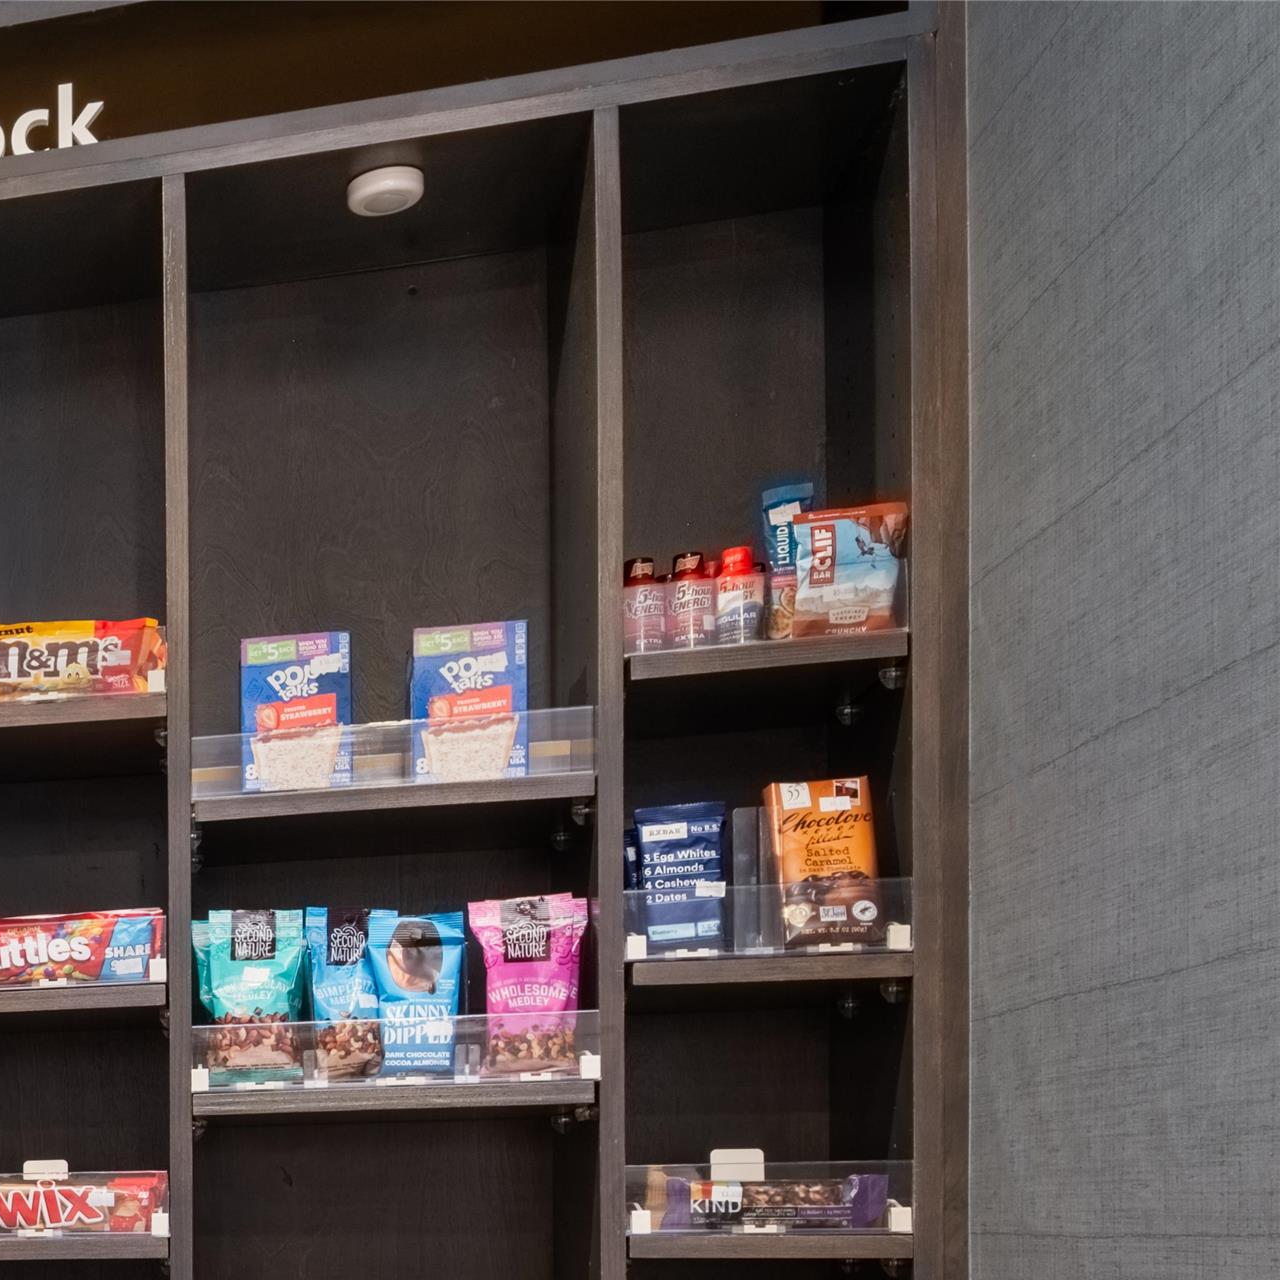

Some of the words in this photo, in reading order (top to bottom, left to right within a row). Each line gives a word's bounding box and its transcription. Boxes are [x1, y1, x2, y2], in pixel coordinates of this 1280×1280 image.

[814, 528, 833, 572] CLIF
[813, 571, 832, 579] BAR
[452, 699, 508, 714] STRAWBERRY
[280, 706, 333, 722] STRAWBERRY
[781, 809, 872, 833] Chocolove
[690, 824, 702, 833] No
[643, 854, 650, 862] 3
[653, 852, 675, 862] Egg
[676, 848, 717, 859] Whites
[806, 846, 850, 857] Salted
[804, 856, 853, 867] Caramel
[644, 867, 651, 876] 6
[654, 862, 705, 875] Almonds
[645, 881, 652, 890] 4
[646, 895, 652, 904] 2
[655, 892, 688, 903] Dates
[105, 943, 151, 959] SHARE
[507, 943, 547, 960] NATURE
[488, 983, 568, 1004] WHOLESOME
[508, 996, 550, 1009] MEDLEY
[385, 1004, 451, 1027] SKINNY
[690, 1199, 742, 1214] KIND
